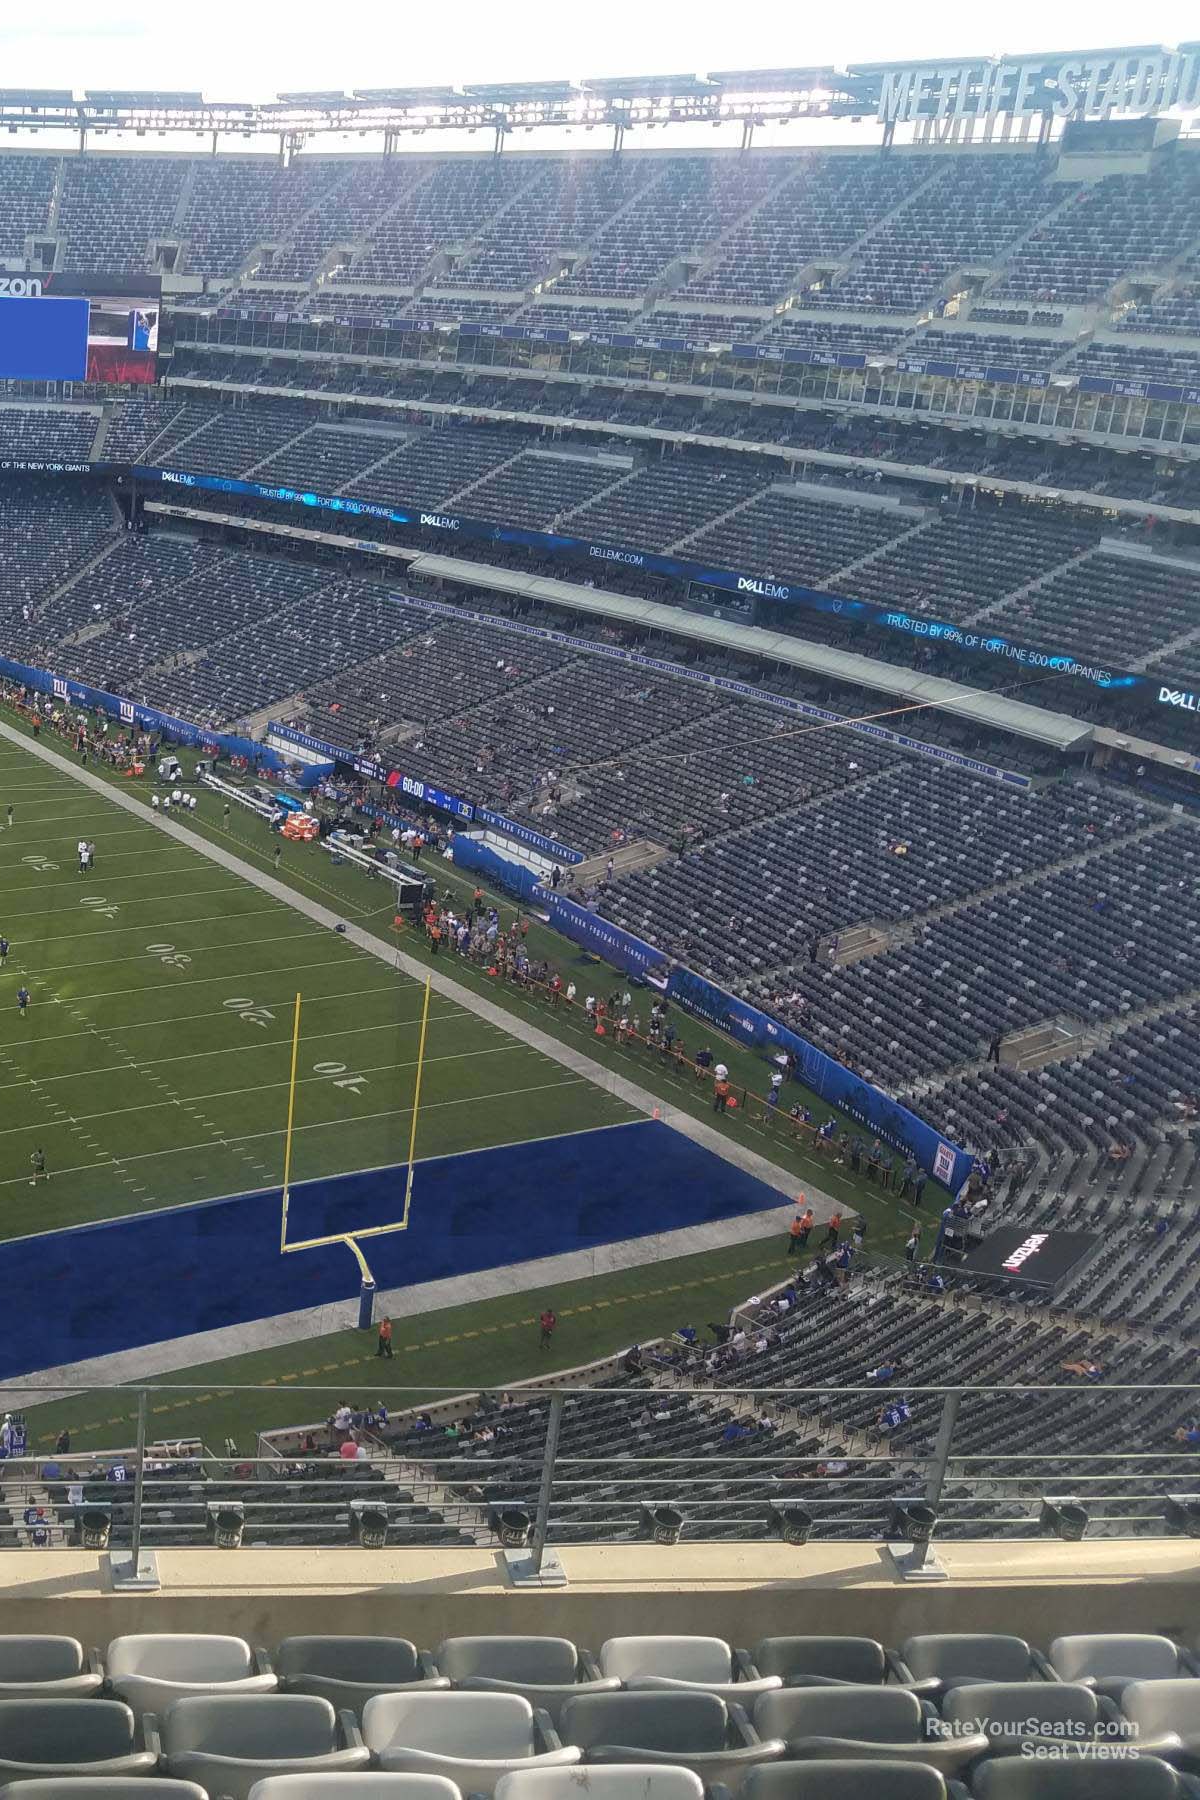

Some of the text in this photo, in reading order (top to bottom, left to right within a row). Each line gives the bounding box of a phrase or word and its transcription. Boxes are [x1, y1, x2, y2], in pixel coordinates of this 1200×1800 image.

[877, 64, 1043, 124] METLIFE
[1, 461, 11, 469] OF
[27, 462, 44, 470] NEW
[45, 463, 64, 471] YORK
[65, 464, 90, 472] GIANTS
[259, 487, 285, 501] TRUSTED
[285, 491, 294, 501] BY
[346, 501, 358, 511] 500
[358, 502, 395, 519] COMPANIES
[589, 546, 644, 566] DELLEMC.COM
[887, 613, 1112, 684] TRUSTED BY 99% OF FORTUNE 500 COMPANIES
[402, 776, 425, 798] 60:00
[21, 855, 60, 871] 50
[79, 896, 121, 914] 40
[145, 943, 192, 964] 30
[222, 998, 276, 1022] 20
[312, 1061, 369, 1088] 10
[1002, 1233, 1049, 1269] verizon
